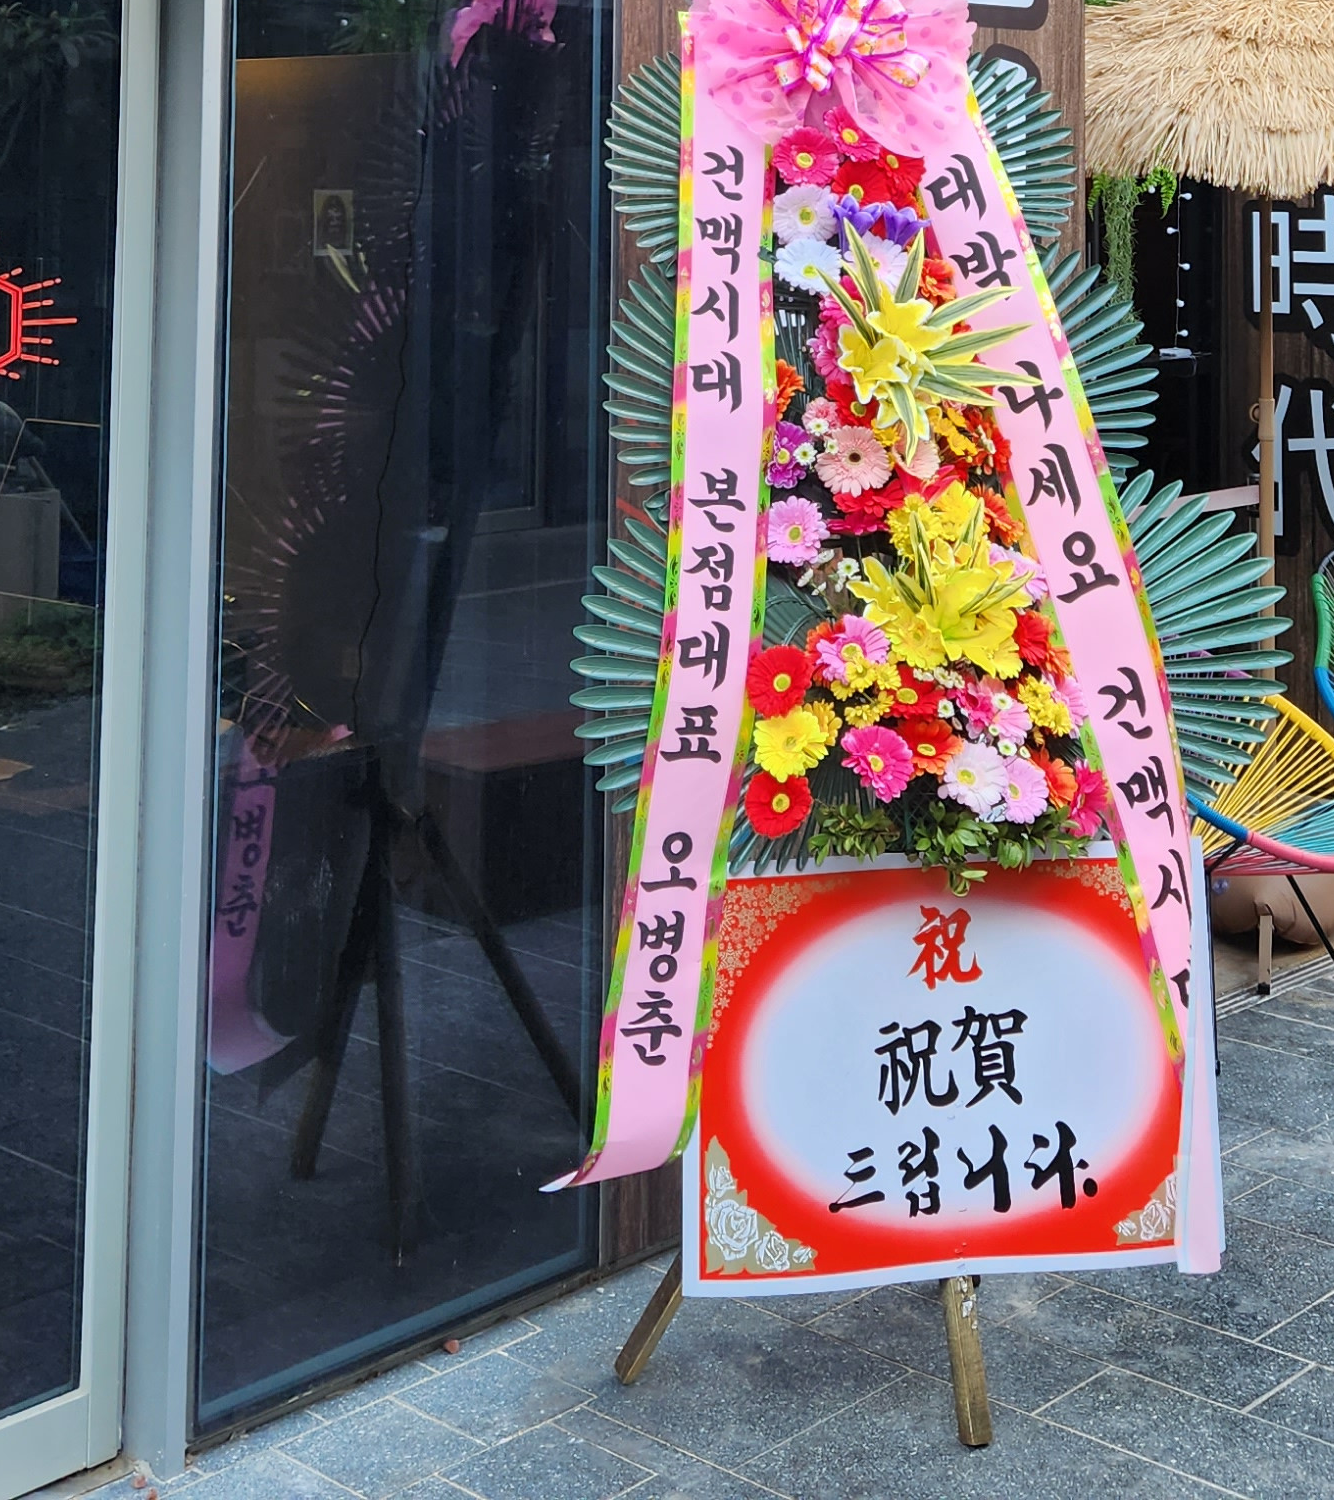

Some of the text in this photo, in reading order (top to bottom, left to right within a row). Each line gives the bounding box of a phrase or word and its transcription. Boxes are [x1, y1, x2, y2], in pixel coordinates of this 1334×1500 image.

[689, 144, 744, 414] 건맥시대
[619, 830, 698, 1067] 오병춘
[905, 903, 983, 991] 祝
[874, 1005, 1029, 1116] 祝賀
